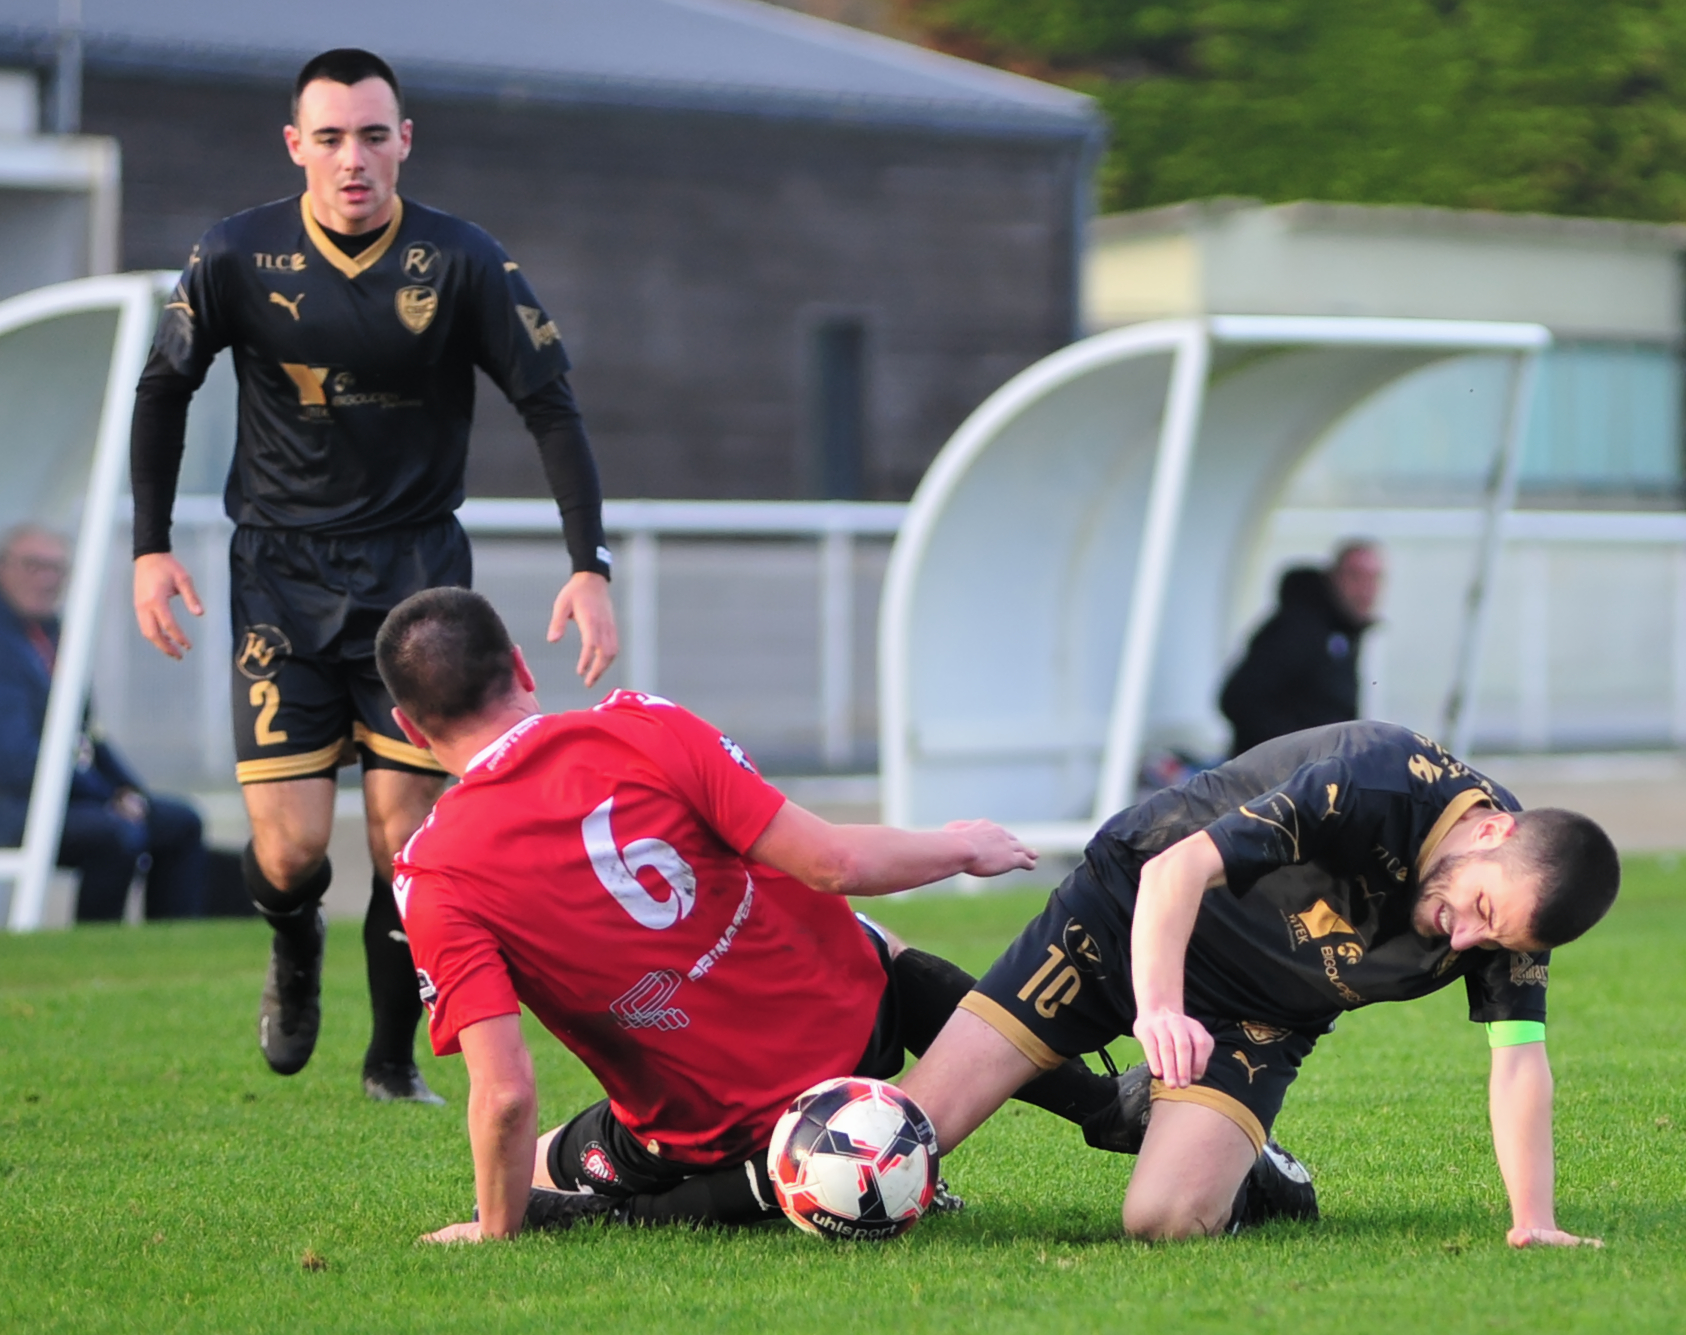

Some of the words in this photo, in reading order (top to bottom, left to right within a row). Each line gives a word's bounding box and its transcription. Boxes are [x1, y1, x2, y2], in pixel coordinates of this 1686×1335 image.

[249, 679, 288, 746] 2
[581, 795, 697, 931] 6
[1015, 942, 1082, 1019] 10
[811, 1212, 897, 1239] uhlsport
